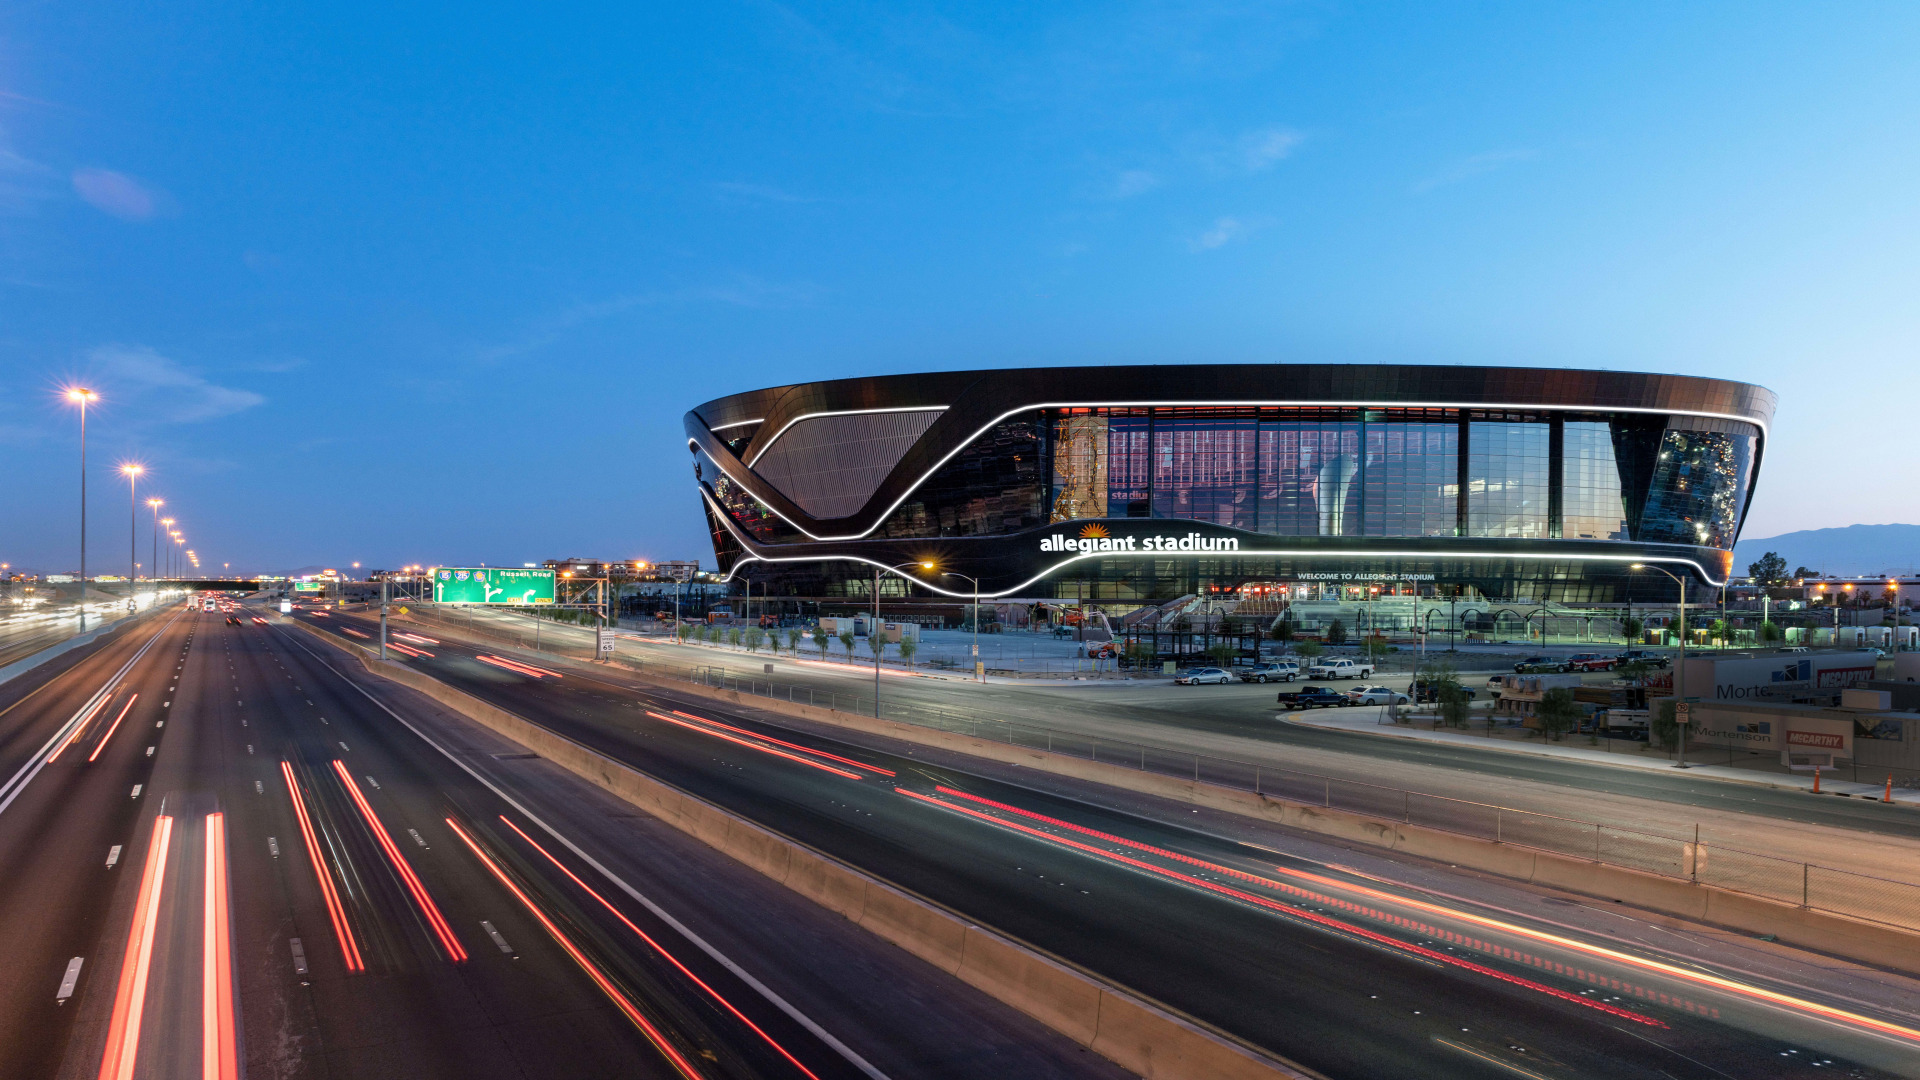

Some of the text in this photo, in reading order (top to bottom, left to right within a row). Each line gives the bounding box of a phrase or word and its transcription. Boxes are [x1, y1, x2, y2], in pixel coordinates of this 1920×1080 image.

[1040, 532, 1239, 555] allegiant stadium
[1717, 684, 1770, 699] Morte
[1694, 726, 1771, 743] Mortenson
